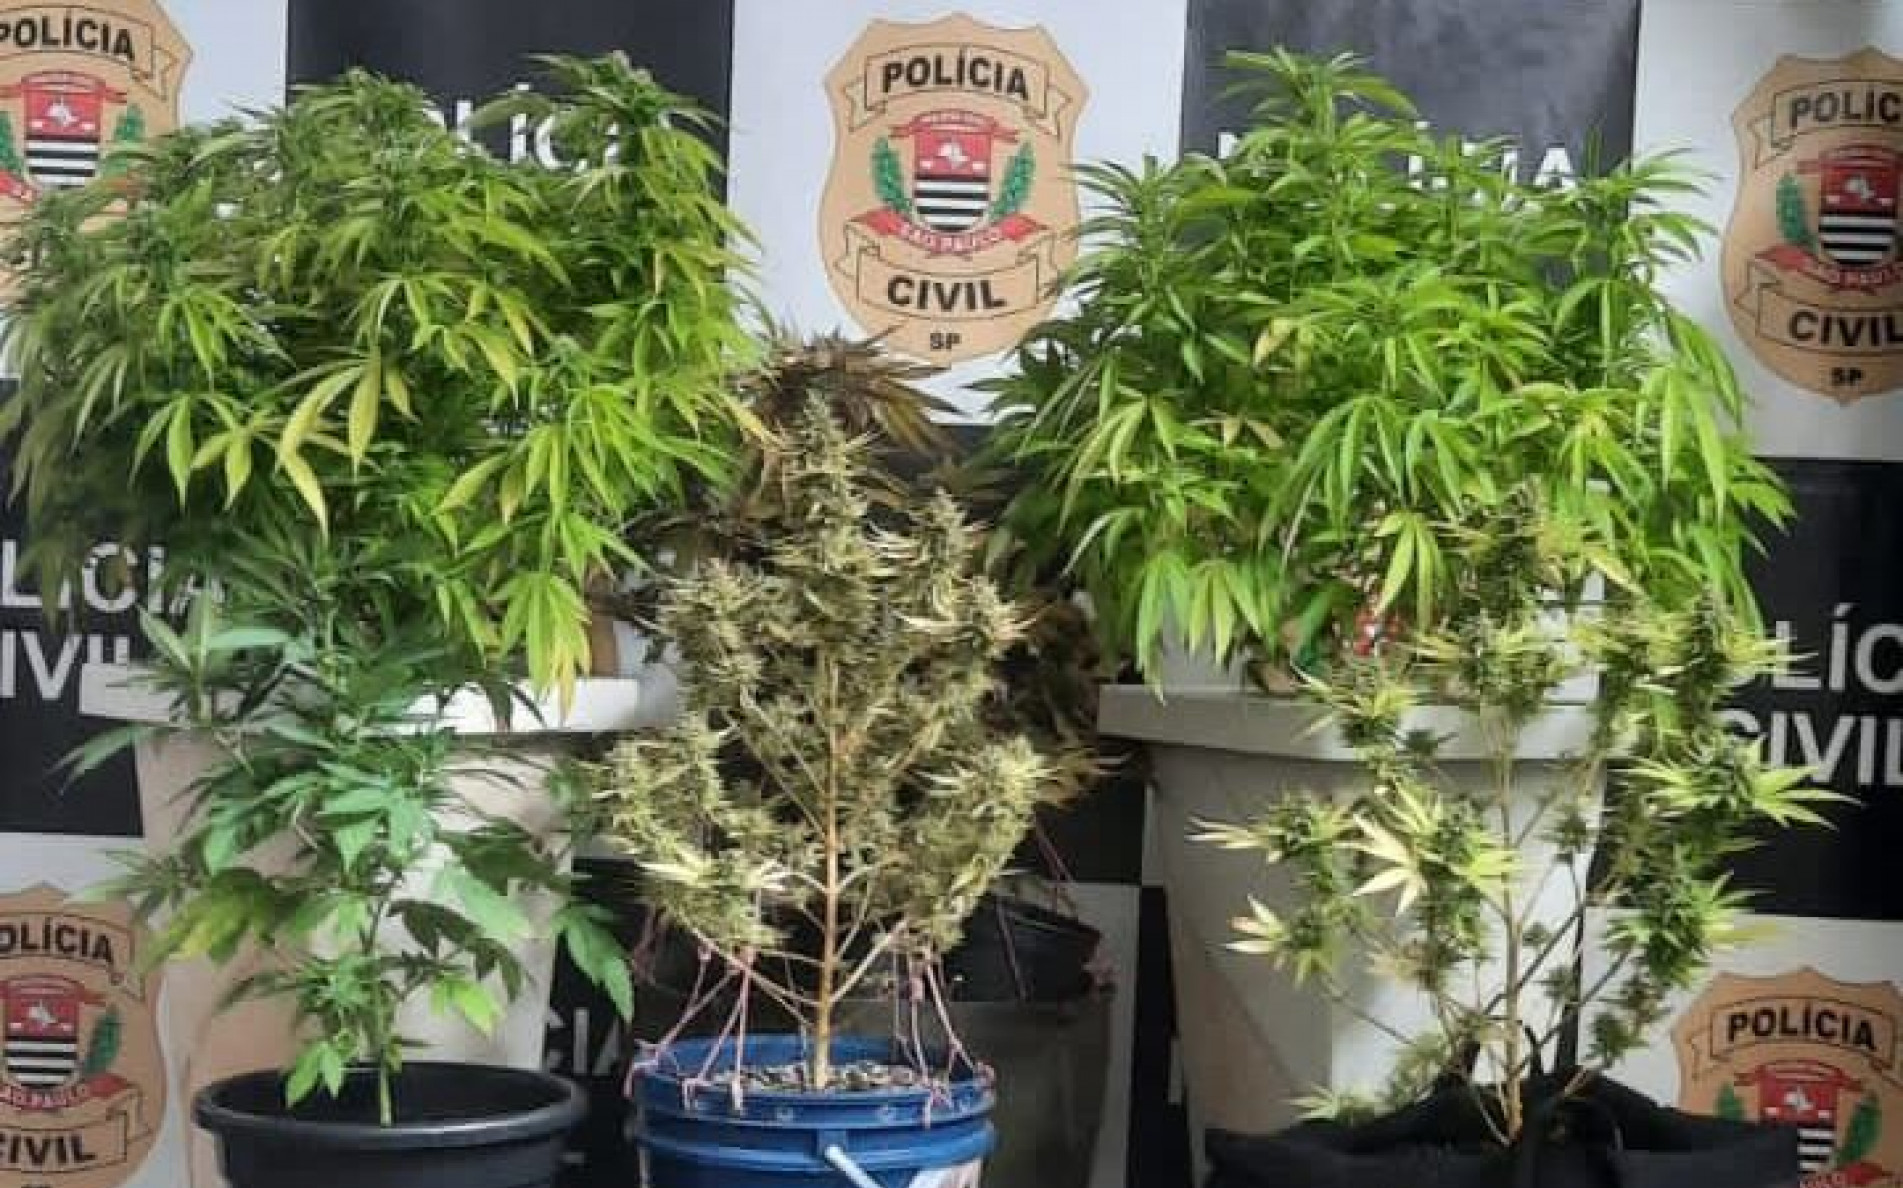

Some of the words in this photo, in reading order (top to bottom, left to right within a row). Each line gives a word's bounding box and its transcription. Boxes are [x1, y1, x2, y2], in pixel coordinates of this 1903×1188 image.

[881, 46, 1030, 100] POLÍCIA
[887, 275, 1009, 312] CIVIL
[929, 332, 963, 350] SP
[1788, 310, 1903, 347] CIVIL
[1830, 366, 1864, 387] SP
[1772, 602, 1903, 693] LÍC
[1727, 1003, 1877, 1051] POLÍCIA
[0, 1132, 97, 1166] IVIL
